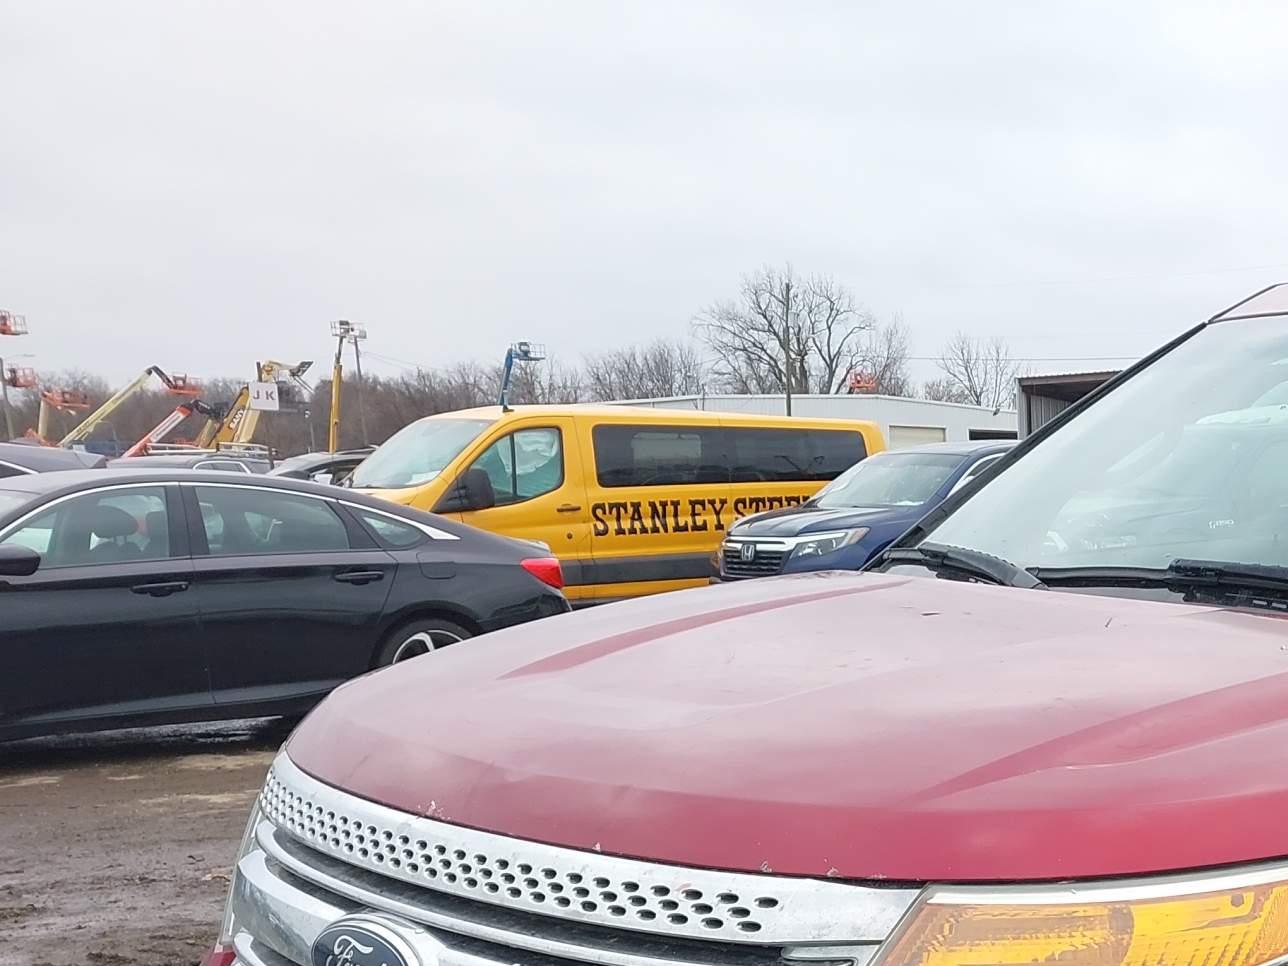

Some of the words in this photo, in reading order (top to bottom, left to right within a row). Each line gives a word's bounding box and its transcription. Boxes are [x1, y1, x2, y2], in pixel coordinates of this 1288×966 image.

[252, 390, 260, 400] J
[265, 390, 276, 401] K
[591, 498, 728, 537] STANLEY
